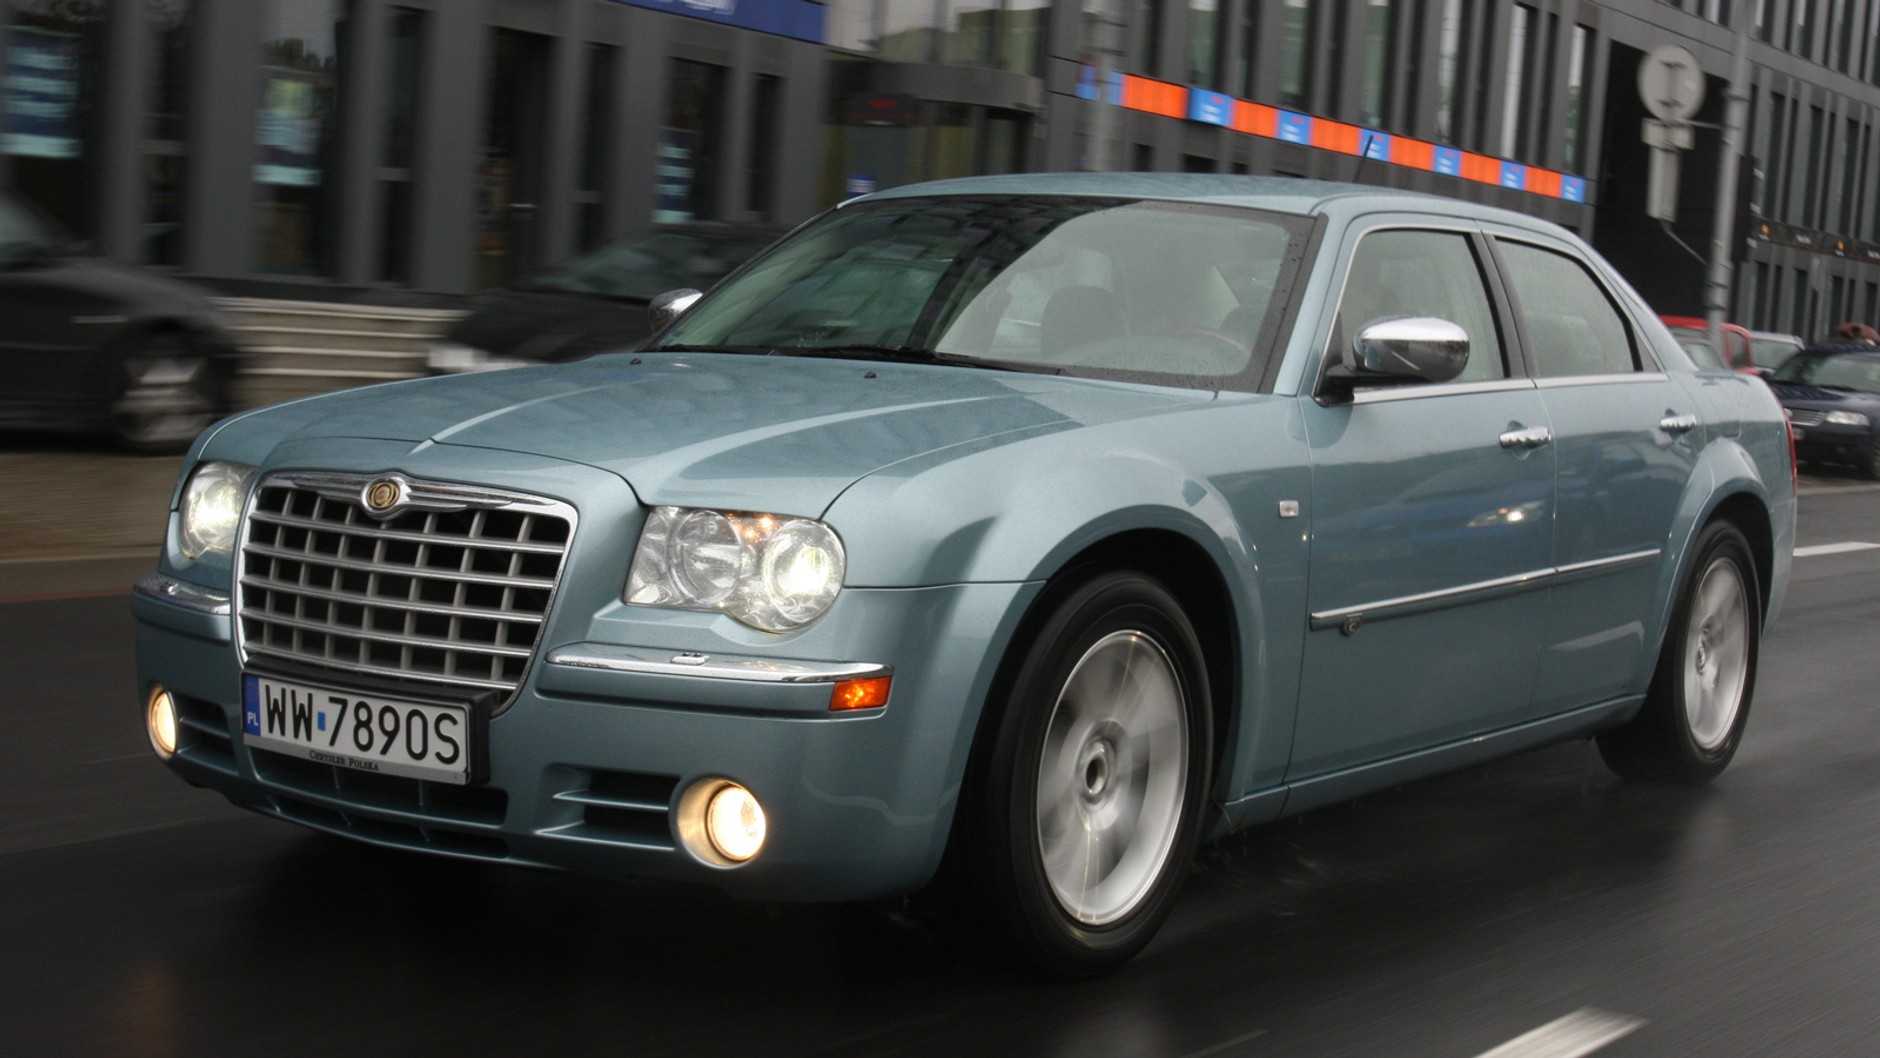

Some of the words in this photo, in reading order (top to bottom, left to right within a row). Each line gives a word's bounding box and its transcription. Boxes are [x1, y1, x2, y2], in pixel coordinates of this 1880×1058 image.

[247, 711, 259, 726] PL
[265, 684, 313, 742] WW
[328, 696, 460, 765] 7890S
[309, 750, 345, 765] CHRYSLER
[348, 757, 379, 771] POLSKA
